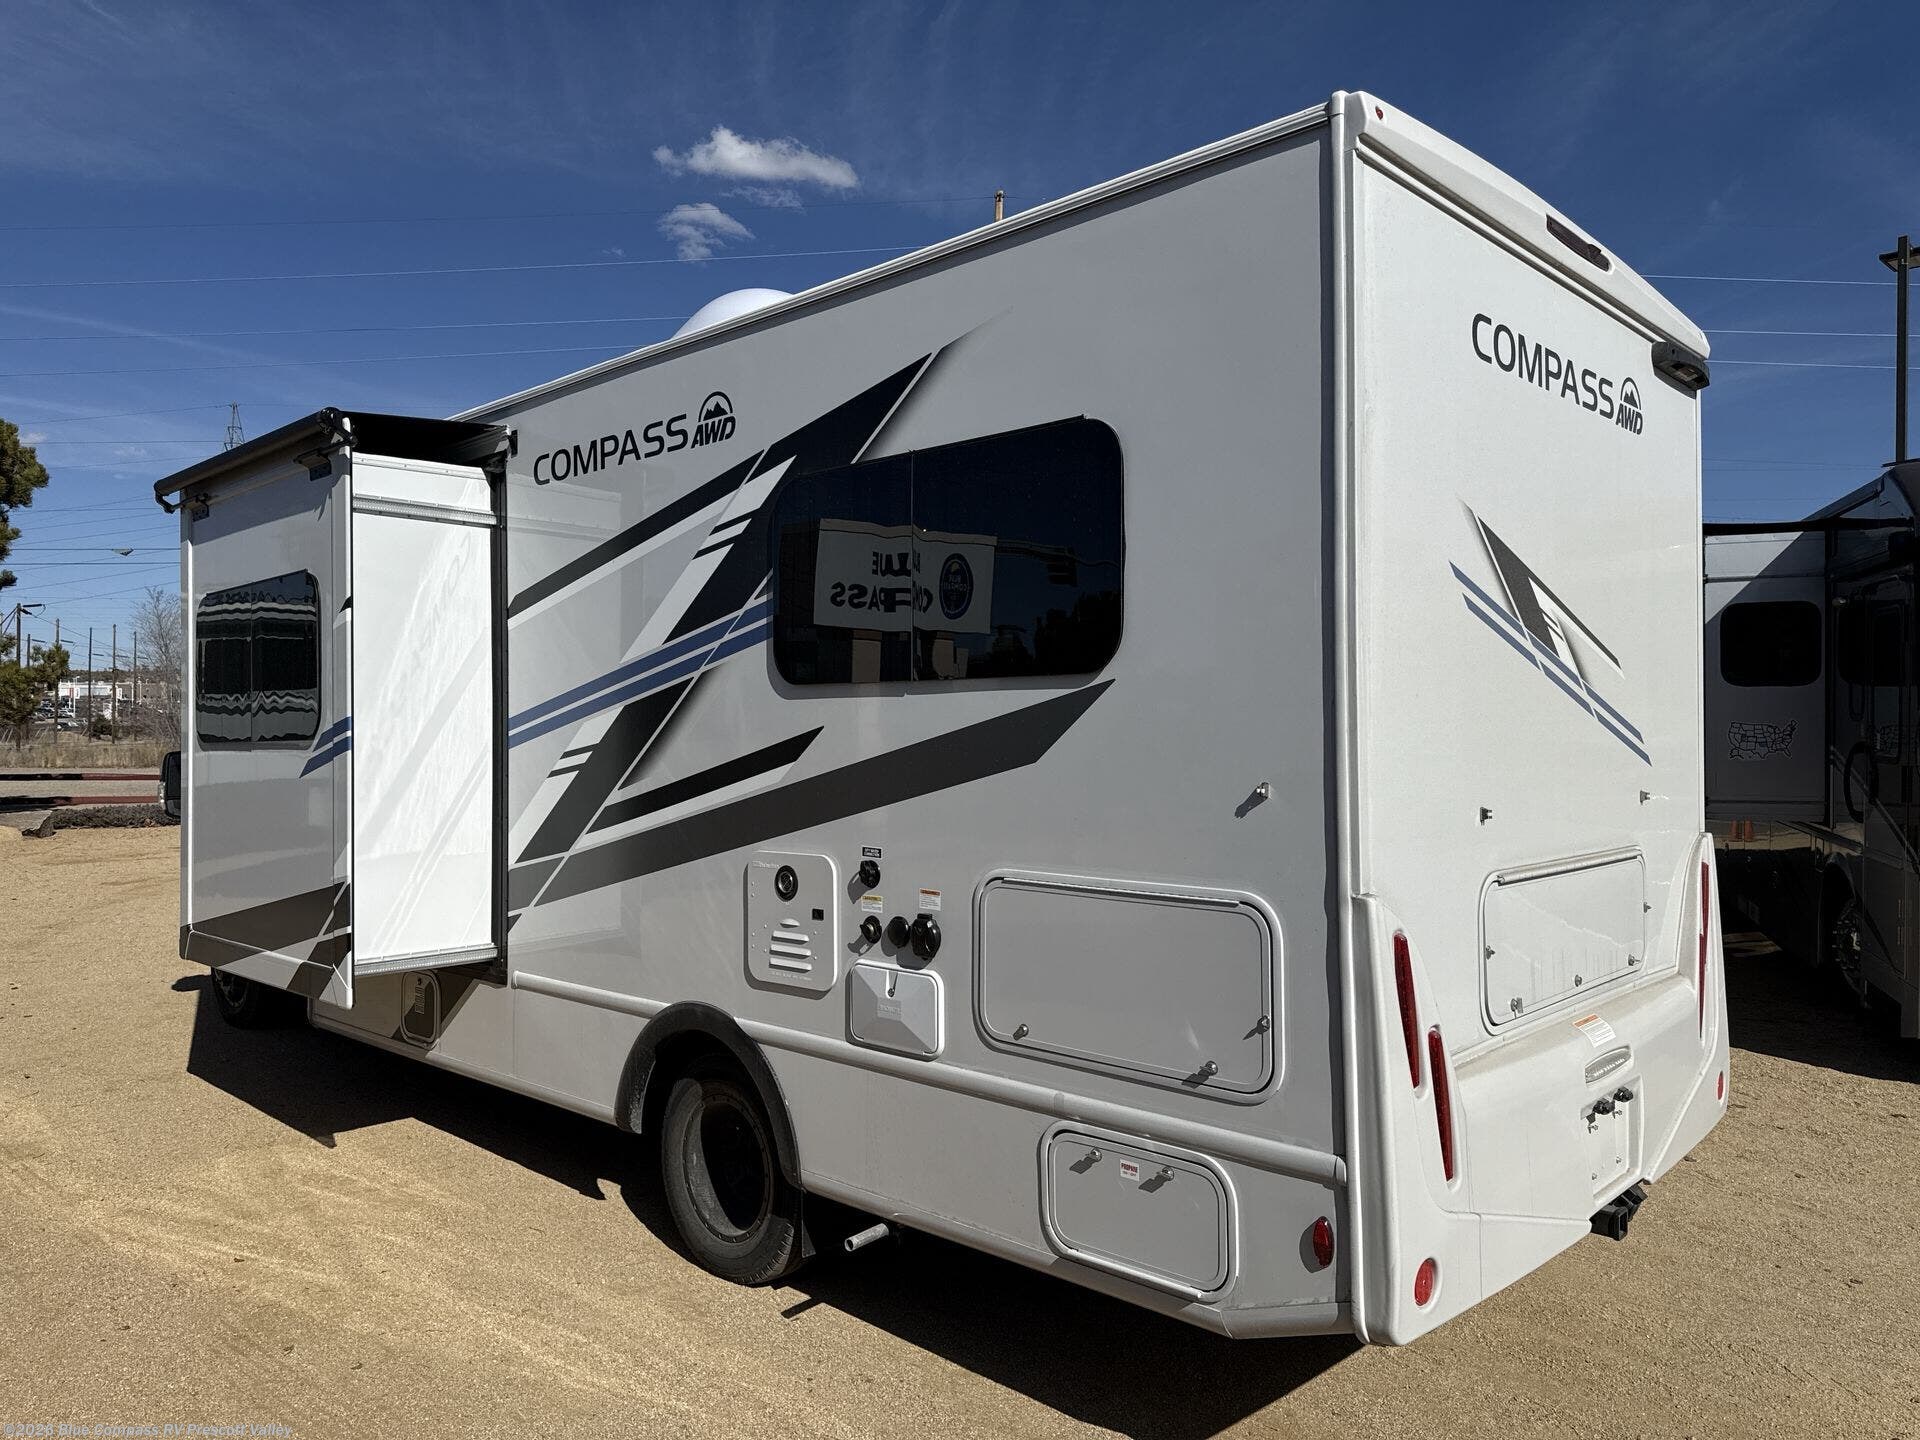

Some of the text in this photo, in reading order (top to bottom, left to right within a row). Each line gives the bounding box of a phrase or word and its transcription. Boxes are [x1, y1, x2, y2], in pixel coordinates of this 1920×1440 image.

[1472, 313, 1614, 420] COMPASS
[690, 415, 736, 449] AWD
[1615, 403, 1643, 435] AWD
[533, 413, 689, 486] COMPASS
